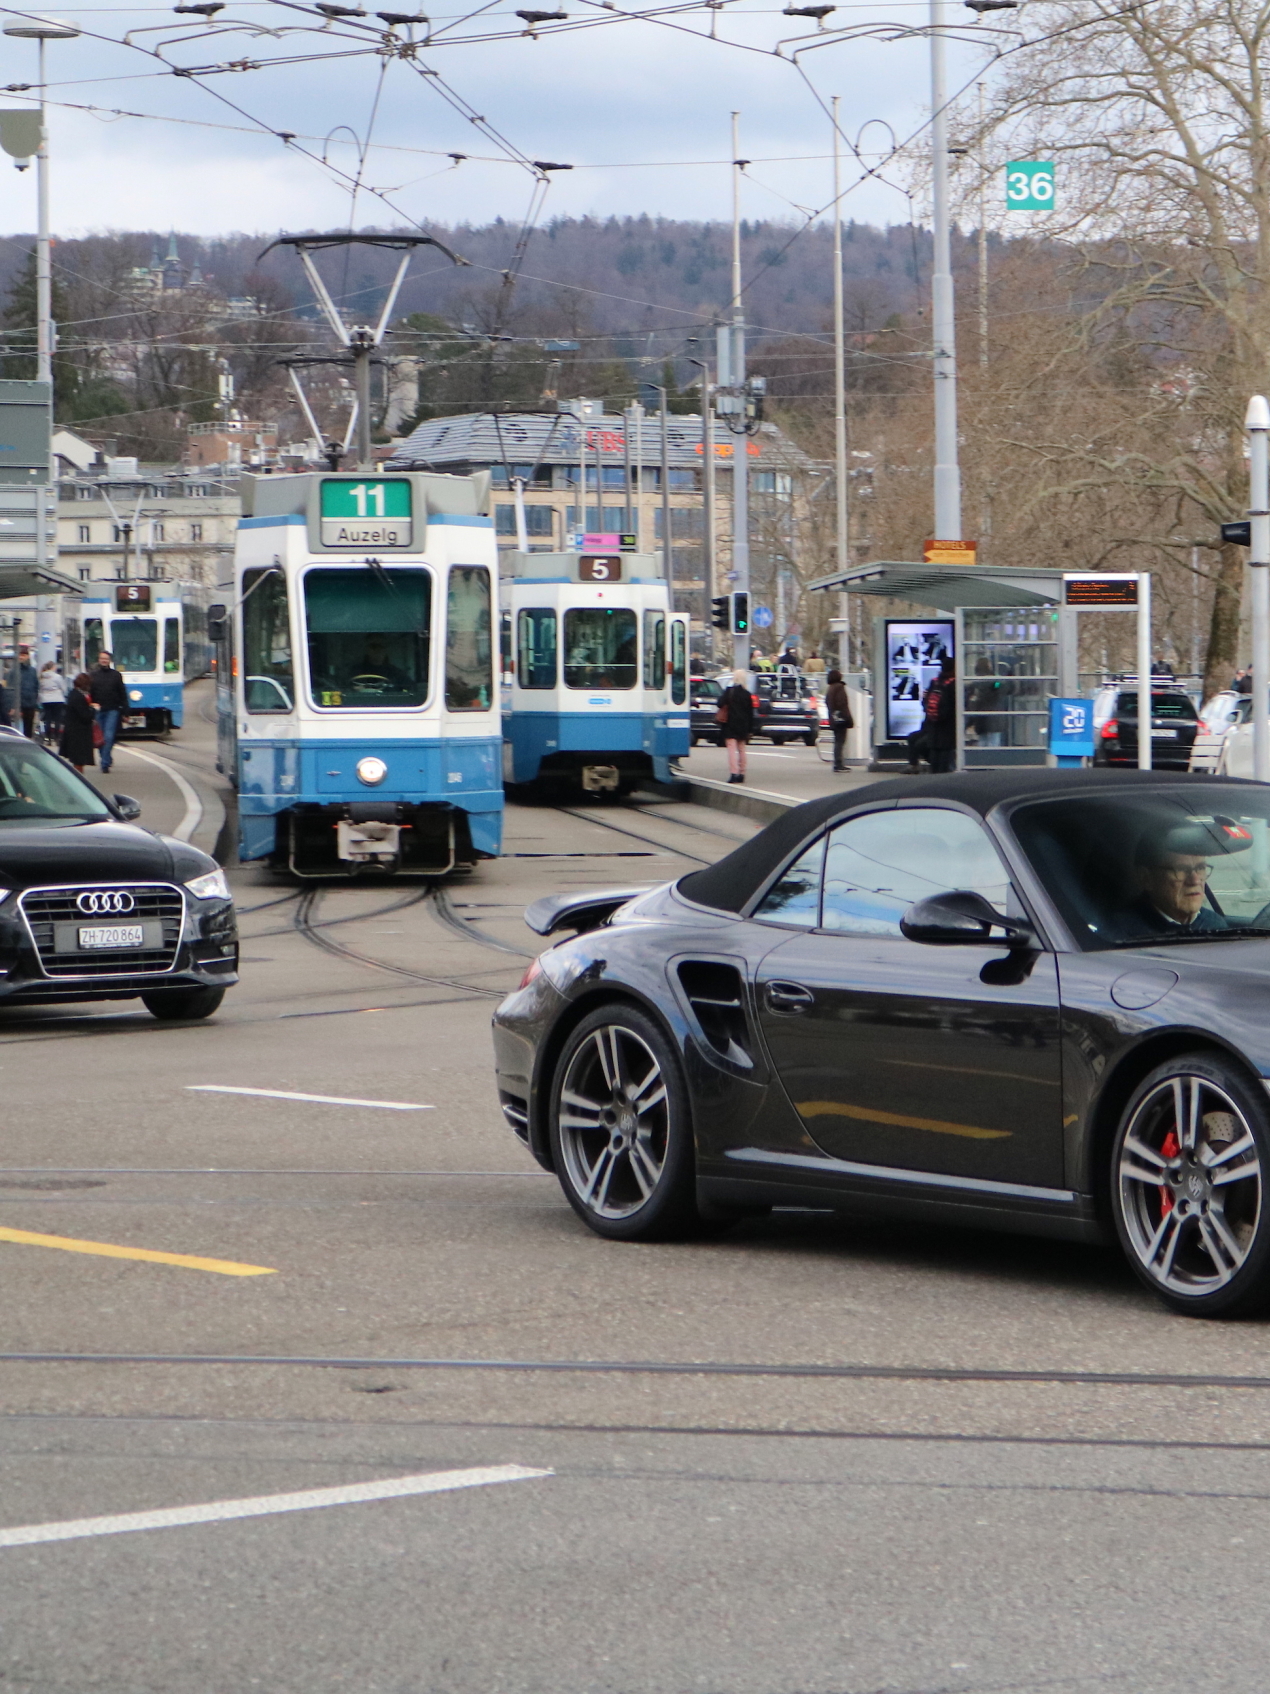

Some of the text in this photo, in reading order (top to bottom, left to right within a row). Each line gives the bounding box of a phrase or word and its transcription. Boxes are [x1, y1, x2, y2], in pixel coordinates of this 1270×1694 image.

[1008, 172, 1053, 200] 36
[349, 484, 385, 516] 11
[338, 528, 397, 545] Auzelg
[591, 559, 609, 579] 5
[128, 587, 139, 599] 5
